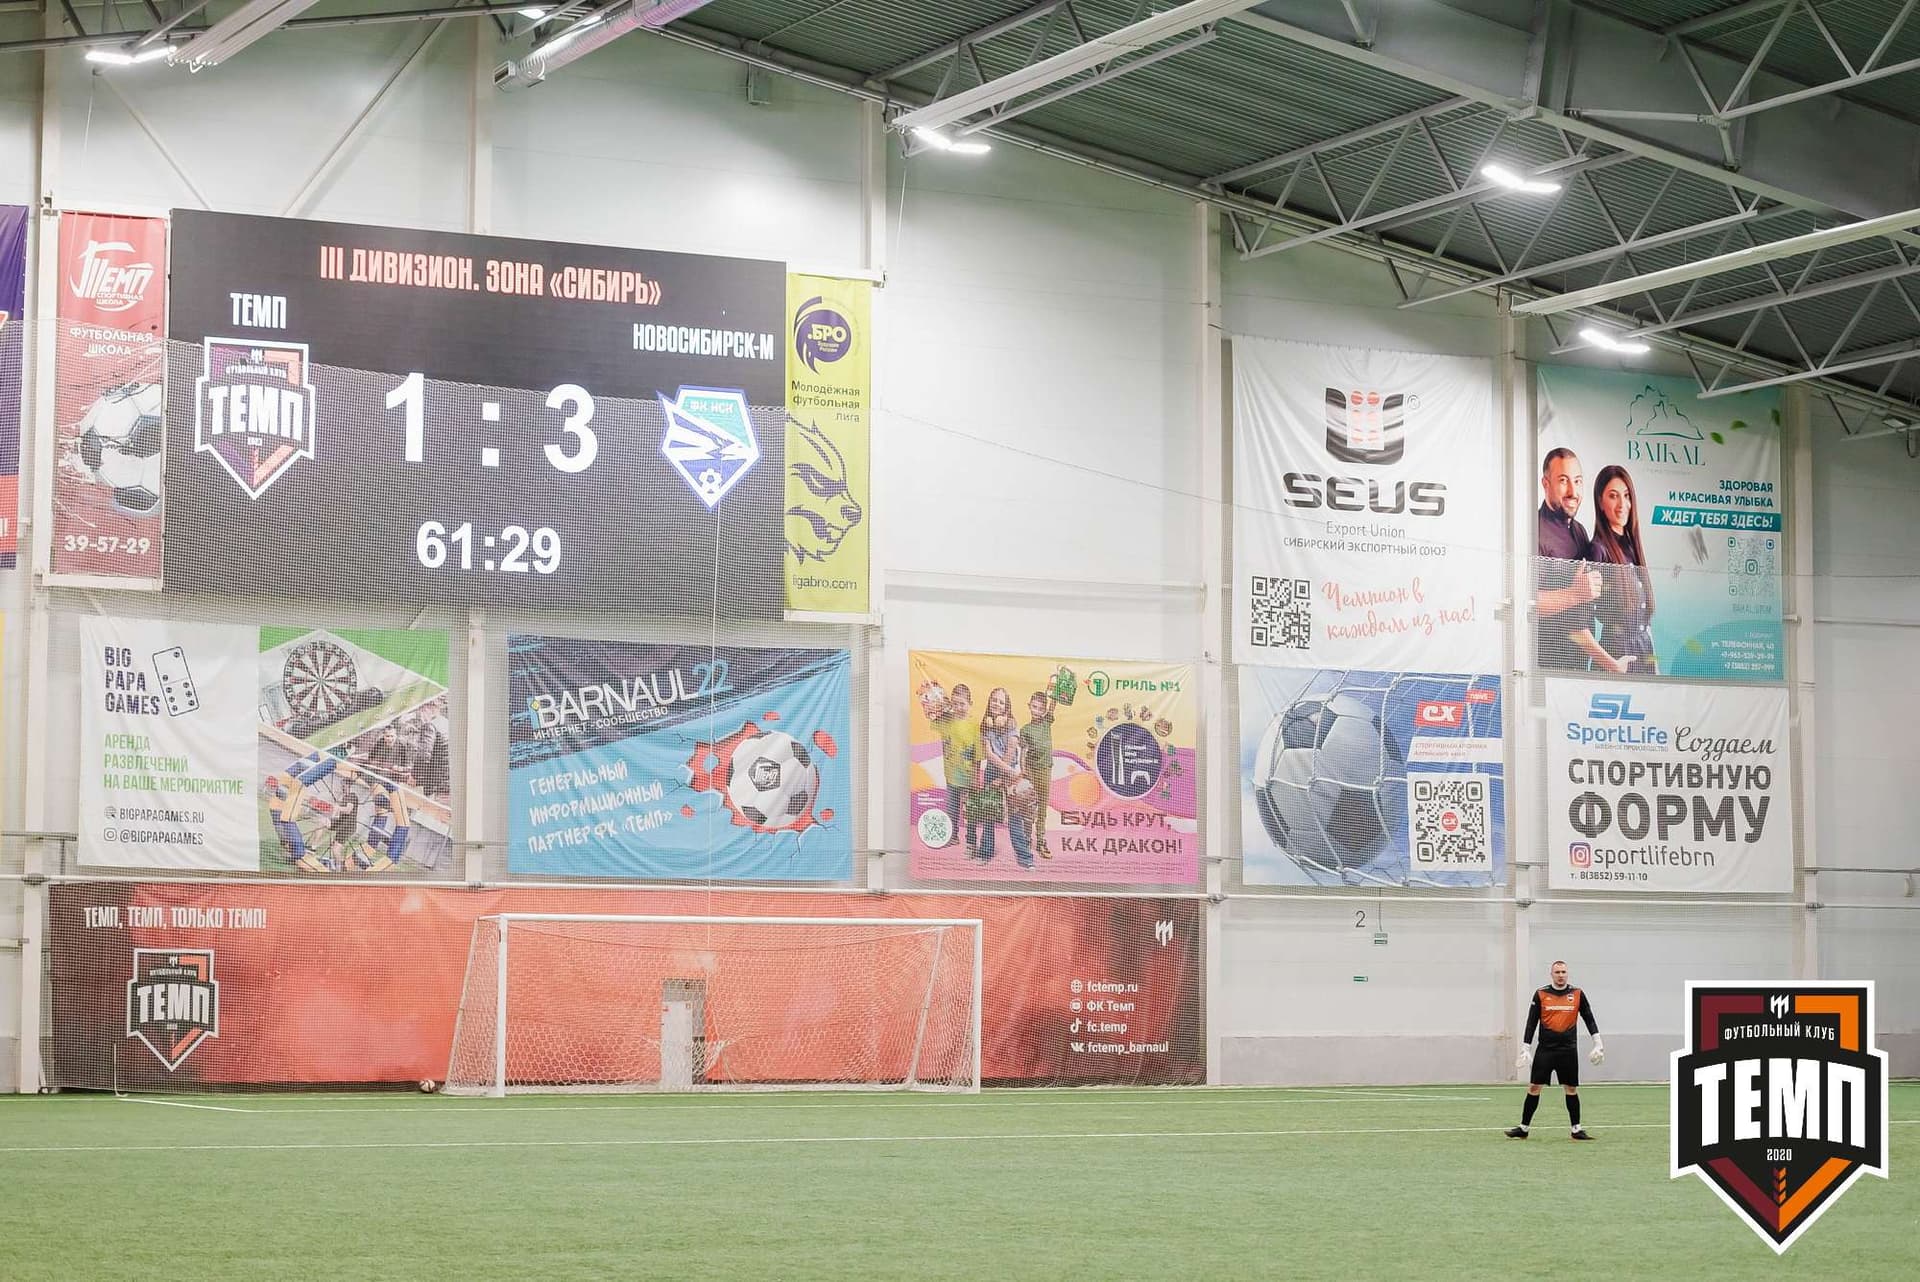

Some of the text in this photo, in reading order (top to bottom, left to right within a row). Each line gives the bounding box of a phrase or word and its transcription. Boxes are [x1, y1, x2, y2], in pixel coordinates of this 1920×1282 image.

[350, 248, 479, 291] ДИВИЗИОН.
[486, 260, 543, 296] ЗОНА
[550, 266, 662, 306] «СИБИРЬ»
[230, 293, 287, 329] ТЕМП
[70, 327, 153, 342] ФУТБОЛЬНАЯ
[633, 323, 775, 361] НОВОСИБИРСК-М
[88, 344, 132, 355] ШКОЛА
[791, 379, 860, 397] Молодёжная
[208, 384, 304, 441] ТЕМП
[835, 412, 860, 422] лига
[386, 373, 425, 462] 1
[544, 384, 598, 474] 3
[1627, 440, 1706, 467] BAIKAL
[1283, 472, 1447, 517] SEUS
[1719, 479, 1774, 493] ЗДОРОВАЯ
[1669, 491, 1773, 508] И КРАСИВАЯ УЛЫБКА
[1326, 520, 1406, 539] Export Union
[1661, 511, 1773, 529] ЖДЕТ ТЕБЯ ЗДЕСЬ!
[64, 535, 151, 555] 39-57-29
[416, 521, 561, 574] 61:29
[1283, 537, 1447, 557] СИБИРСКИЙ ЭКСПОРТНЫЙ СОЮЗ
[1321, 576, 1424, 612] Чемпион в
[1327, 596, 1475, 640] каждом из нас!
[104, 645, 132, 668] BIG
[104, 669, 147, 691] PAPA
[1115, 679, 1157, 691] ГРИЛЬ
[104, 692, 161, 716] GAMES
[104, 733, 151, 752] АРЕНДА
[1566, 722, 1668, 745] SportLife
[1675, 726, 1777, 761] Создаем
[104, 752, 189, 773] РАЗВЛЕЧЕНИЙ
[529, 758, 628, 797] ГЕНЕРАЛЬНЫЙ
[1568, 758, 1772, 790] СПОРТИВНУЮ
[104, 775, 244, 795] НА ВАШЕ МЕРОПРИЯТИЕ
[529, 779, 663, 827] ИНФОРМАЦИОННЫЙ
[119, 807, 205, 824] BIGPAPAGAMES.RU
[1060, 811, 1172, 830] БУДЬ КРУТ,
[1569, 791, 1771, 843] ФОРМУ
[119, 828, 204, 845] @BIGPAPAGAMES
[528, 809, 673, 854] ПАРТНЕР ФК «ТЕМП»
[1062, 837, 1184, 856] КАК ДРАКОН!
[1593, 845, 1716, 868] sportlifebrn
[1580, 870, 1613, 881] 8(3852)
[1614, 872, 1648, 881] 59-11-10
[84, 907, 267, 930] ТЕМП, ТЕМП, ТОЛЬКО ТЕМП!
[1355, 910, 1366, 928] 2
[1087, 981, 1138, 994] fctemp.ru
[137, 983, 210, 1024] ТЕМП
[1087, 1000, 1135, 1012] ФК Темп
[1087, 1021, 1128, 1034] fc.temp
[1087, 1041, 1169, 1055] fctemp_barnaul
